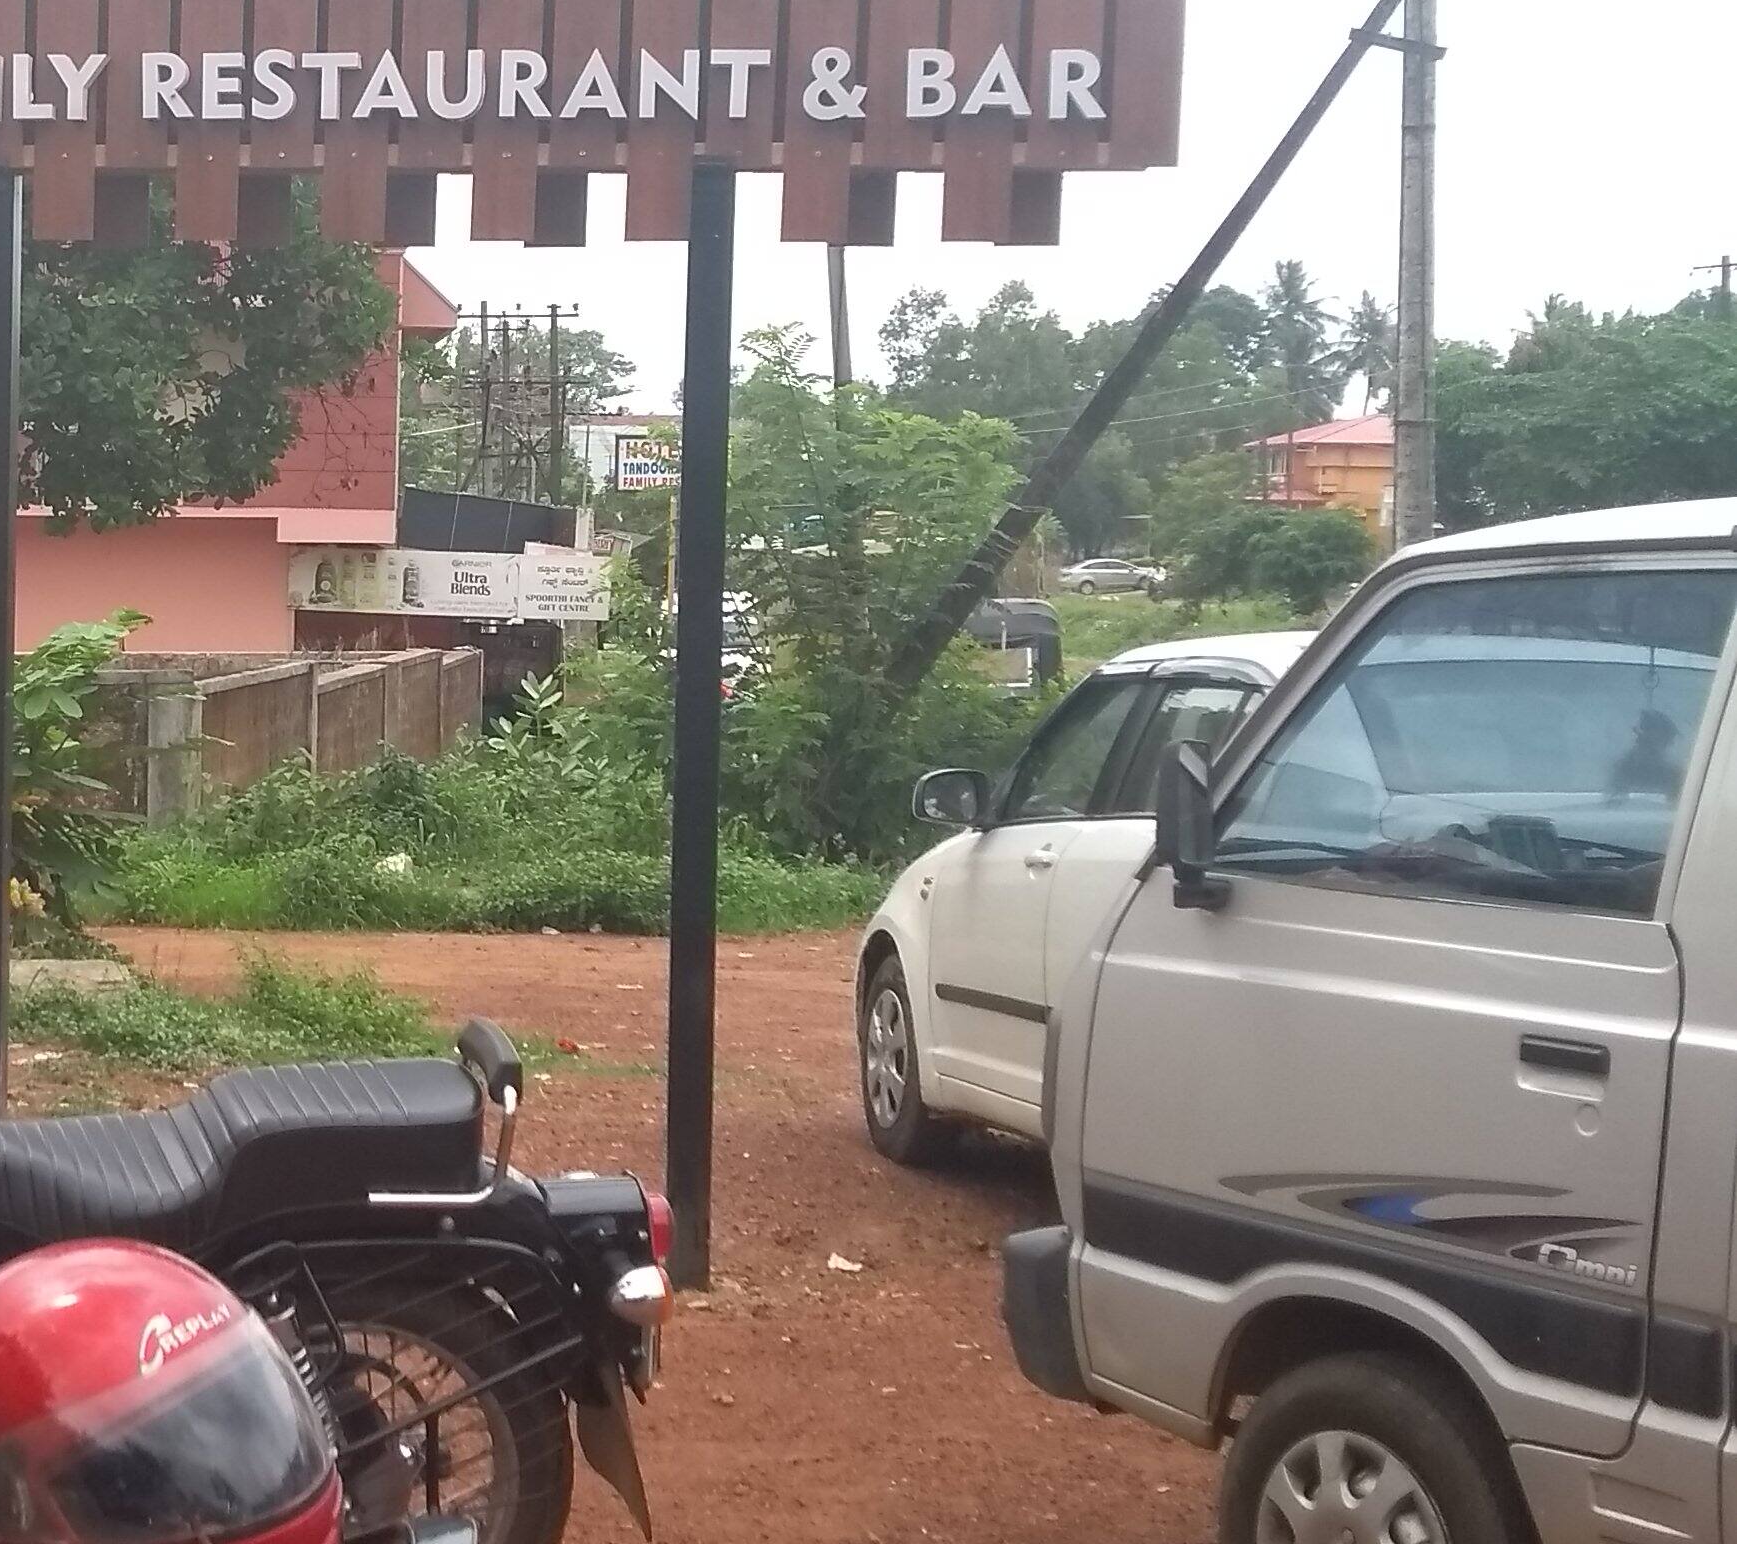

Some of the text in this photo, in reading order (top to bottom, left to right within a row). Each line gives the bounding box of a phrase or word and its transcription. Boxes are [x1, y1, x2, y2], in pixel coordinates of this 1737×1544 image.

[141, 47, 772, 121] RESTAURANT
[802, 46, 869, 120] &
[906, 42, 1109, 120] BAR
[454, 571, 487, 584] Ultra
[450, 583, 491, 596] Blends
[538, 603, 589, 612] GIFT CENTRE
[1537, 1243, 1638, 1288] Omni
